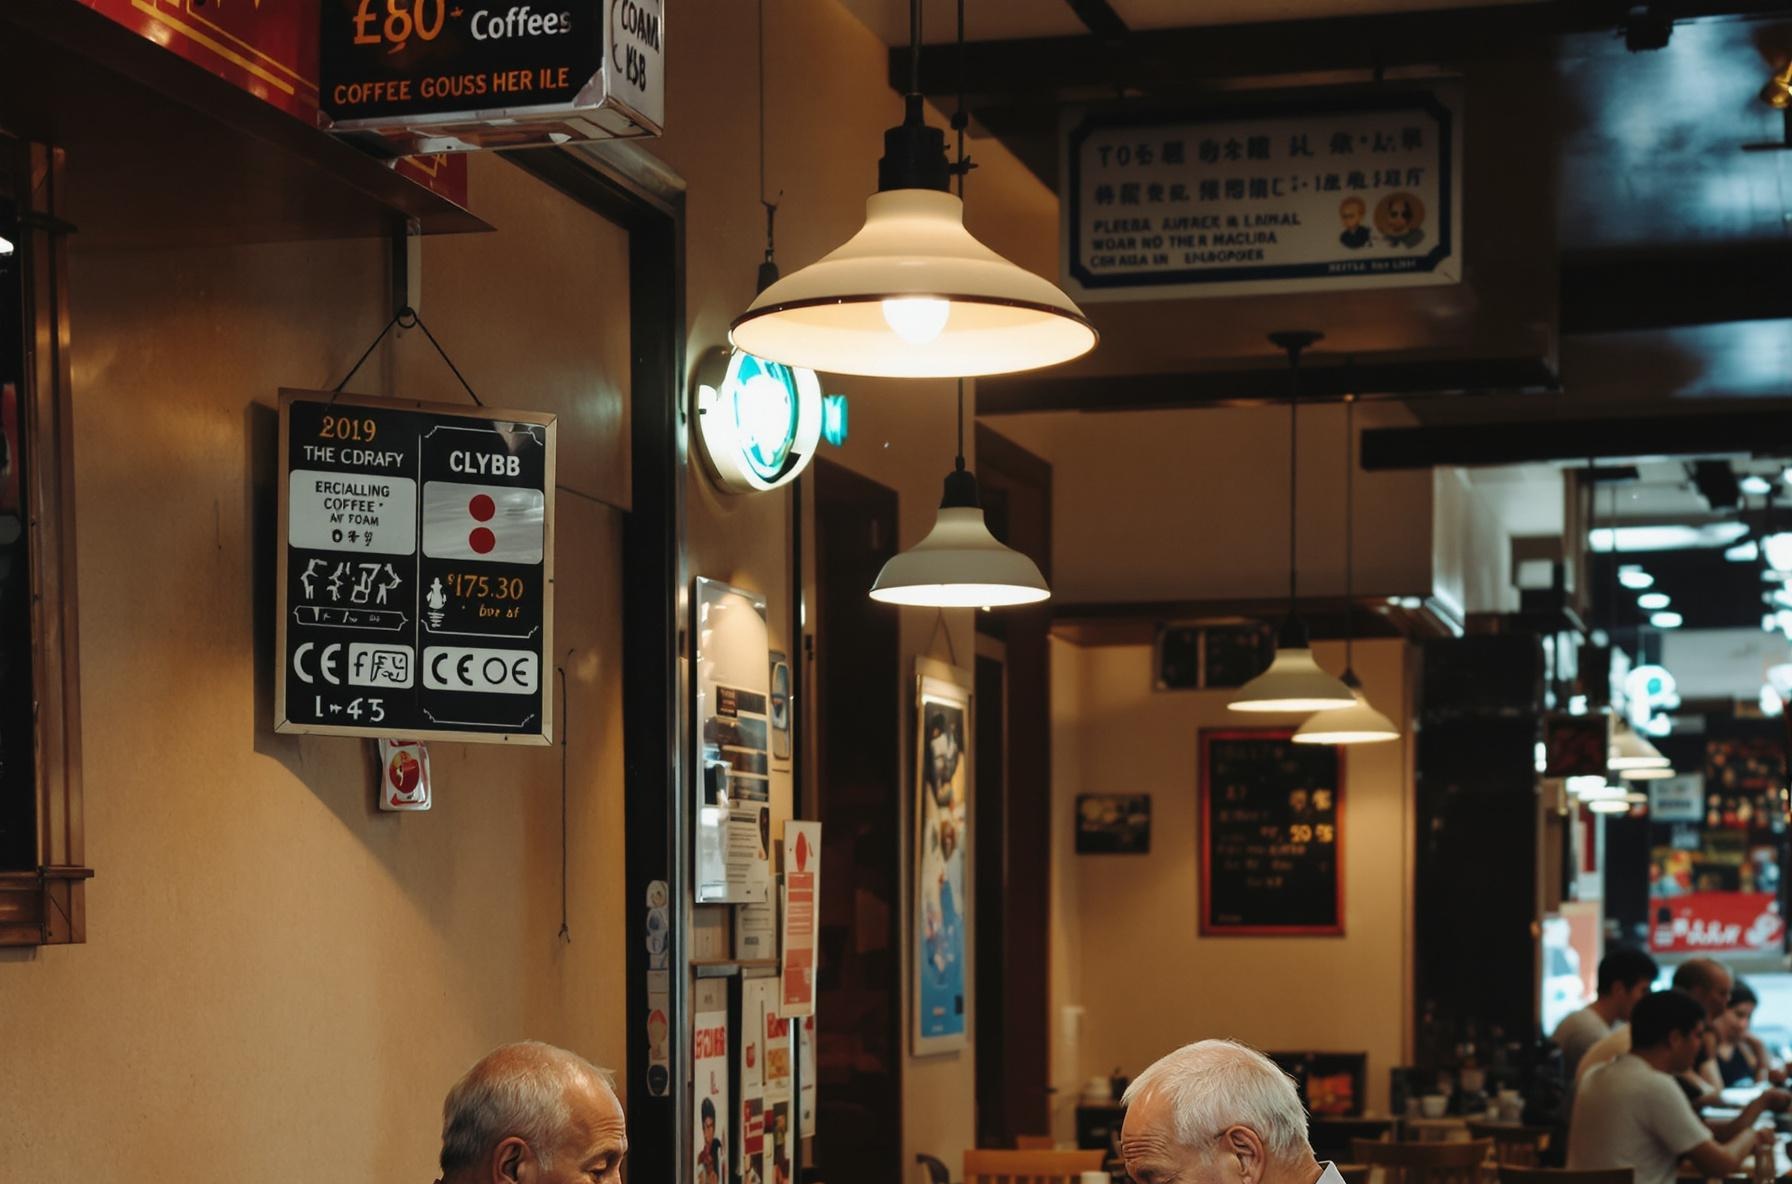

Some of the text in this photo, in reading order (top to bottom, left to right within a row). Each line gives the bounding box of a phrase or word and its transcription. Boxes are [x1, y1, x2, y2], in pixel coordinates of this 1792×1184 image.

[470, 7, 571, 41] Coffees
[333, 67, 570, 106] COFFEE GOUSS HER ILE
[319, 415, 377, 443] 2019
[303, 445, 336, 464] THE
[449, 450, 521, 477] CLYBB
[323, 497, 375, 513] COFFEE
